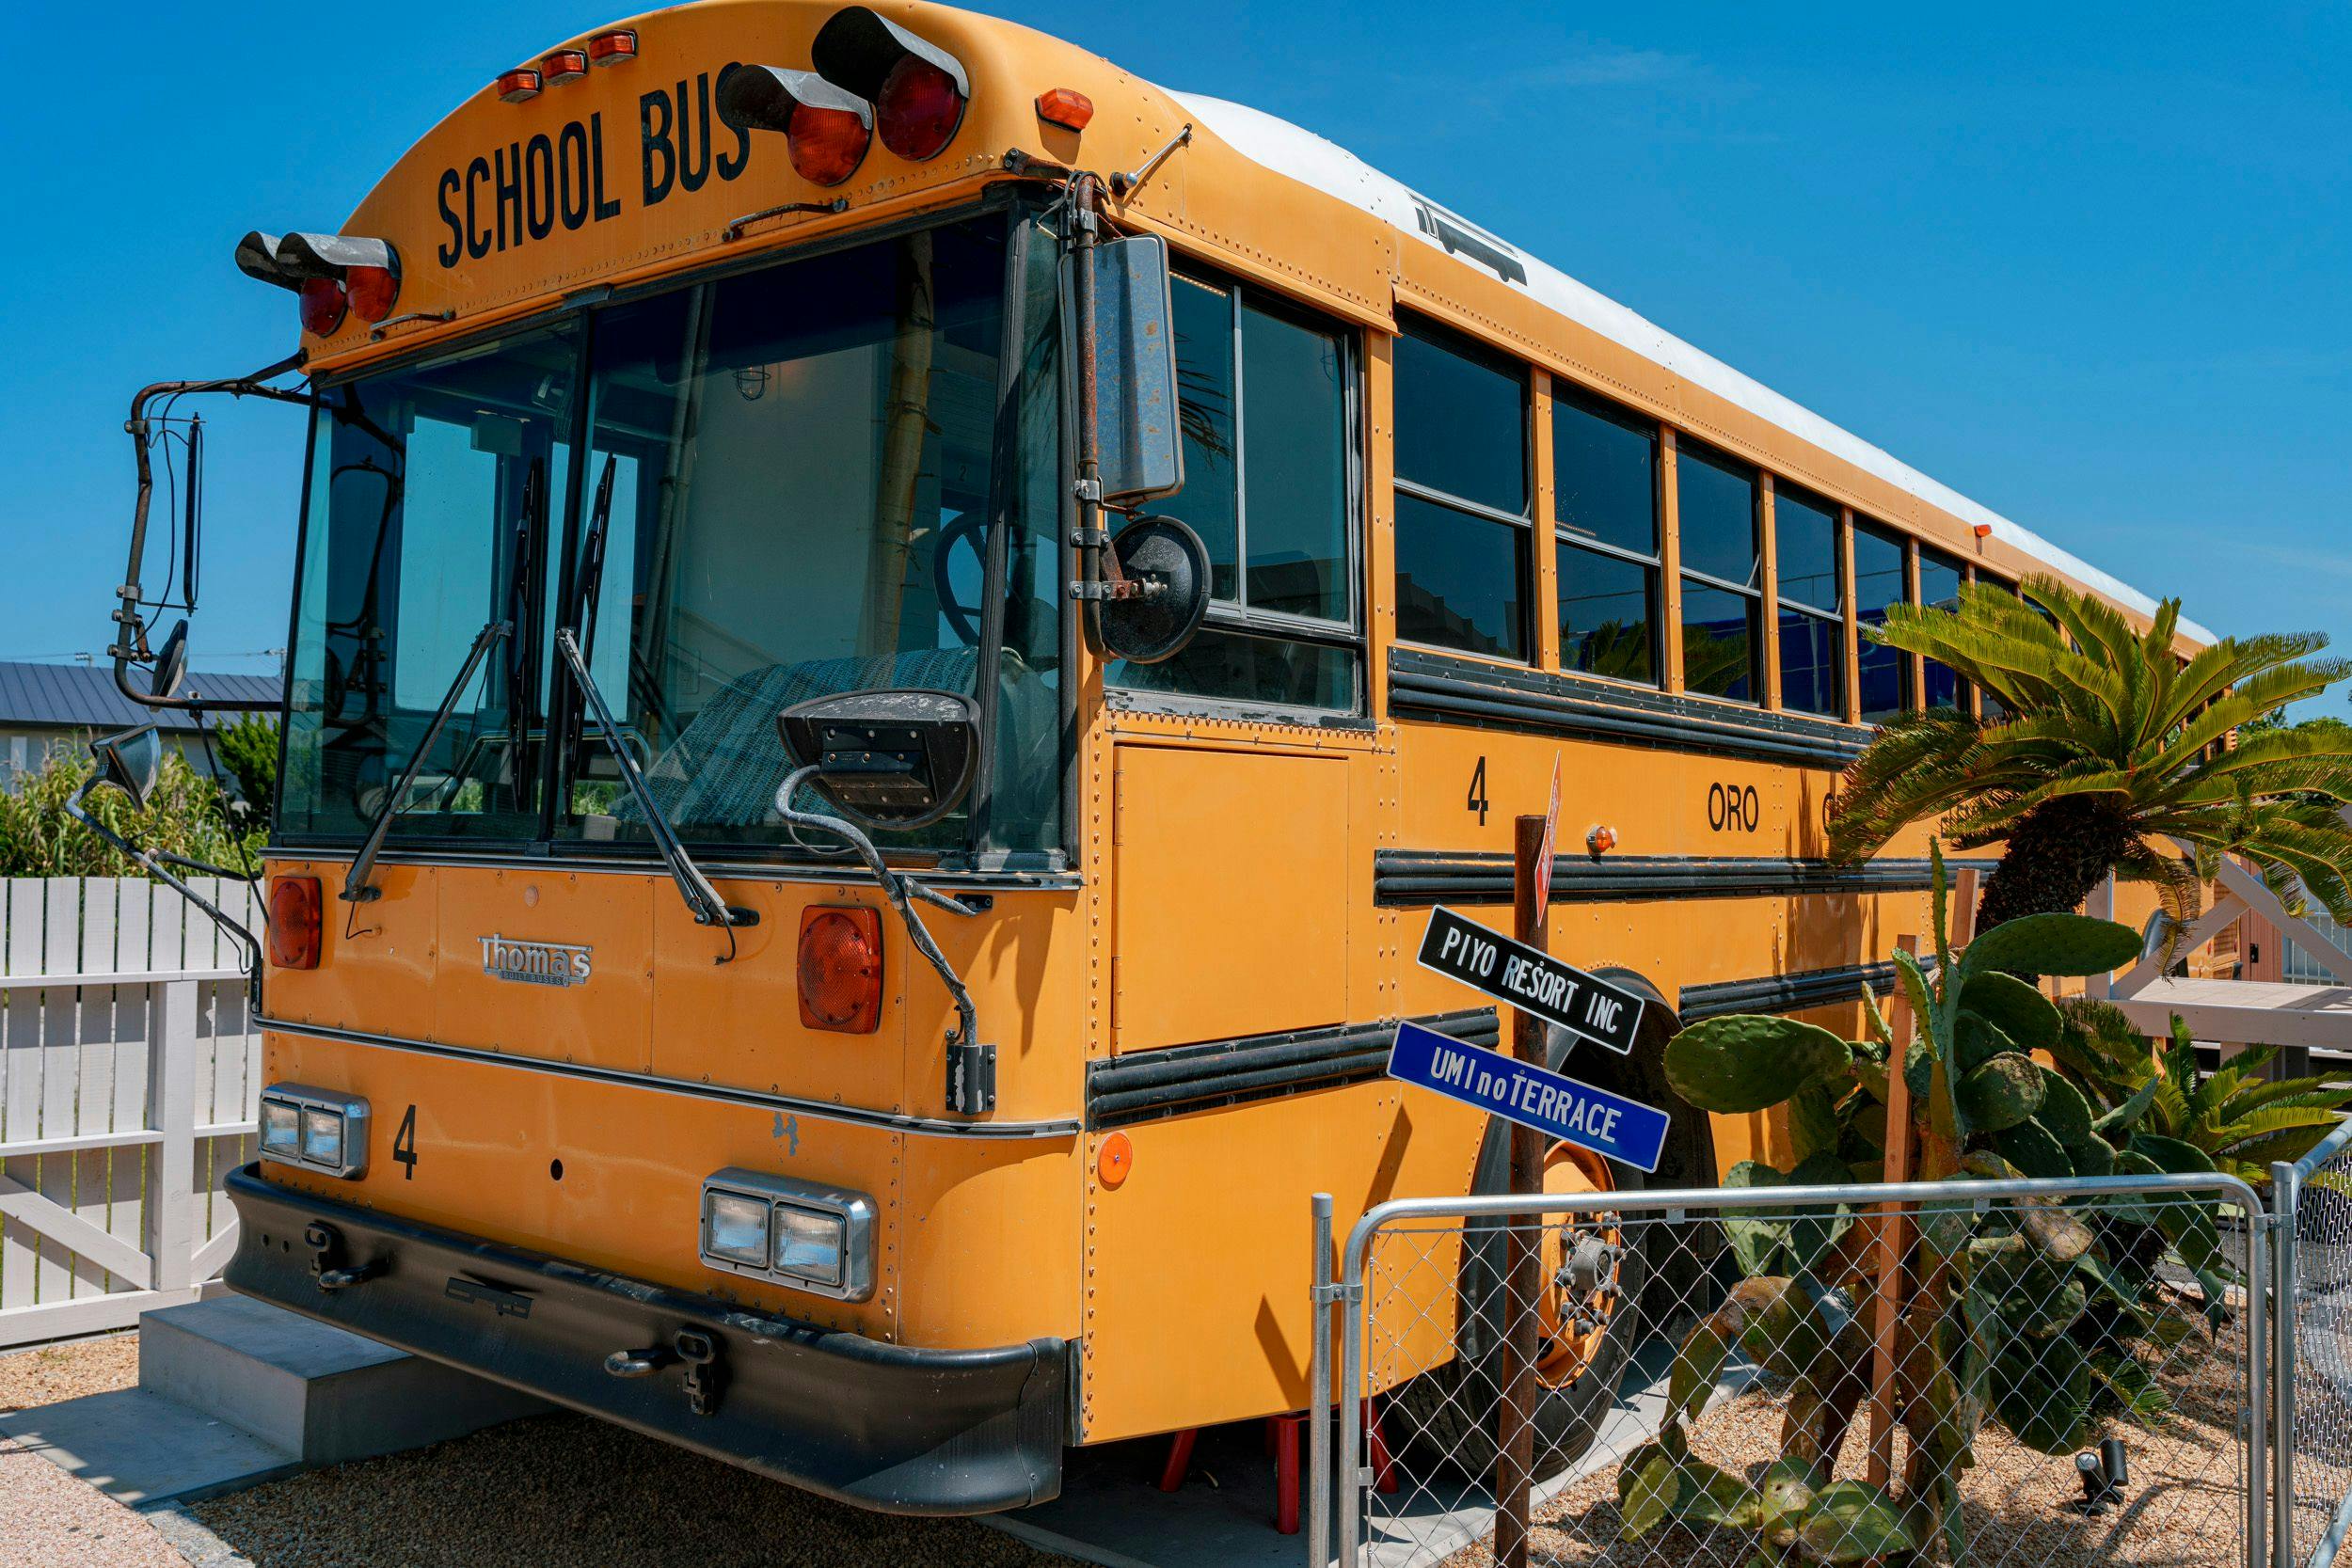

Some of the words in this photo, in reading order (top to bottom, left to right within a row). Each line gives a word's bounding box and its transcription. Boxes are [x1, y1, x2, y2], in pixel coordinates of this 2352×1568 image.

[438, 111, 620, 269] SCHOOL
[640, 61, 750, 207] BUS
[1467, 755, 1488, 826] 4
[1708, 783, 1759, 832] ORO
[1440, 927, 1496, 977] PIYO
[1502, 954, 1579, 1013] RESORT
[1585, 991, 1623, 1034] INC
[391, 1103, 418, 1180] 4
